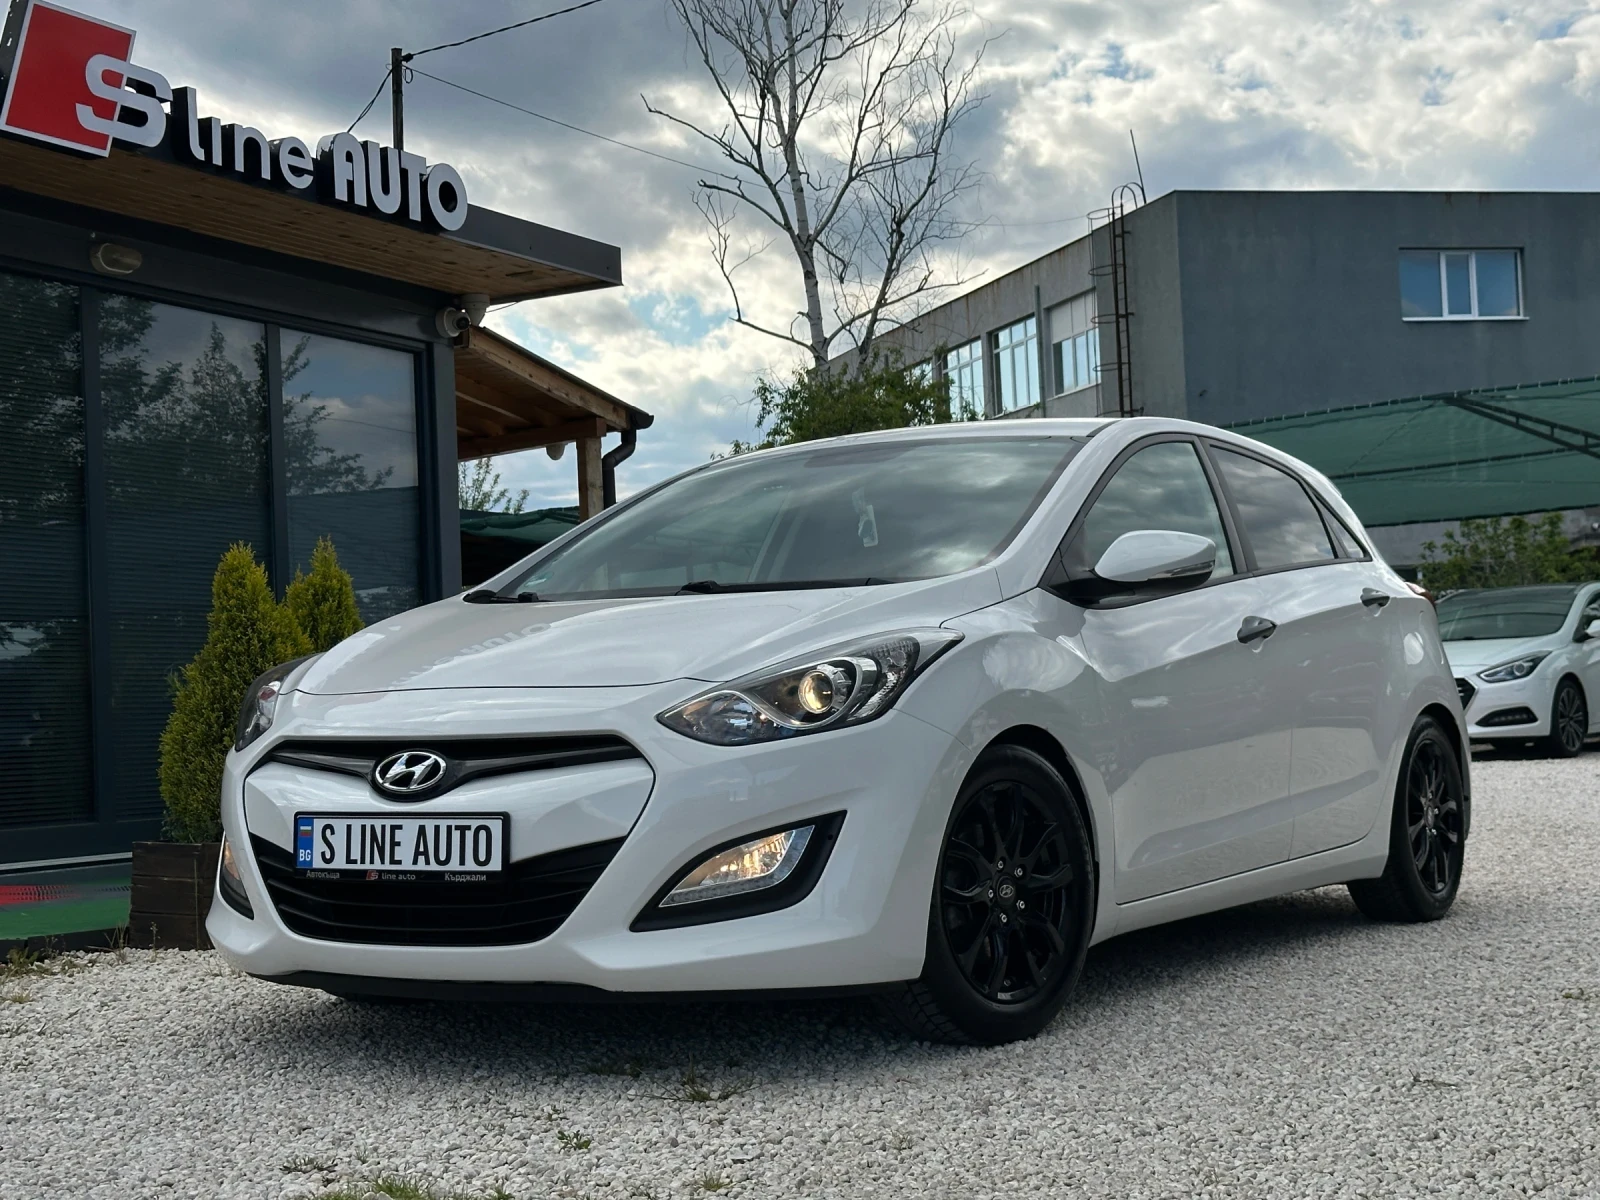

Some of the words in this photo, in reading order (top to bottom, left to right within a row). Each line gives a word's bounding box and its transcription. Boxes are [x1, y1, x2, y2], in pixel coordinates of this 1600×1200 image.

[75, 53, 173, 148] S
[186, 86, 314, 189] line
[332, 131, 468, 231] AUTO
[320, 823, 336, 864] S
[345, 823, 403, 866] LINE
[412, 824, 493, 867] AUTO
[299, 849, 312, 861] BG
[381, 872, 396, 880] line
[444, 872, 487, 882] Кърджали
